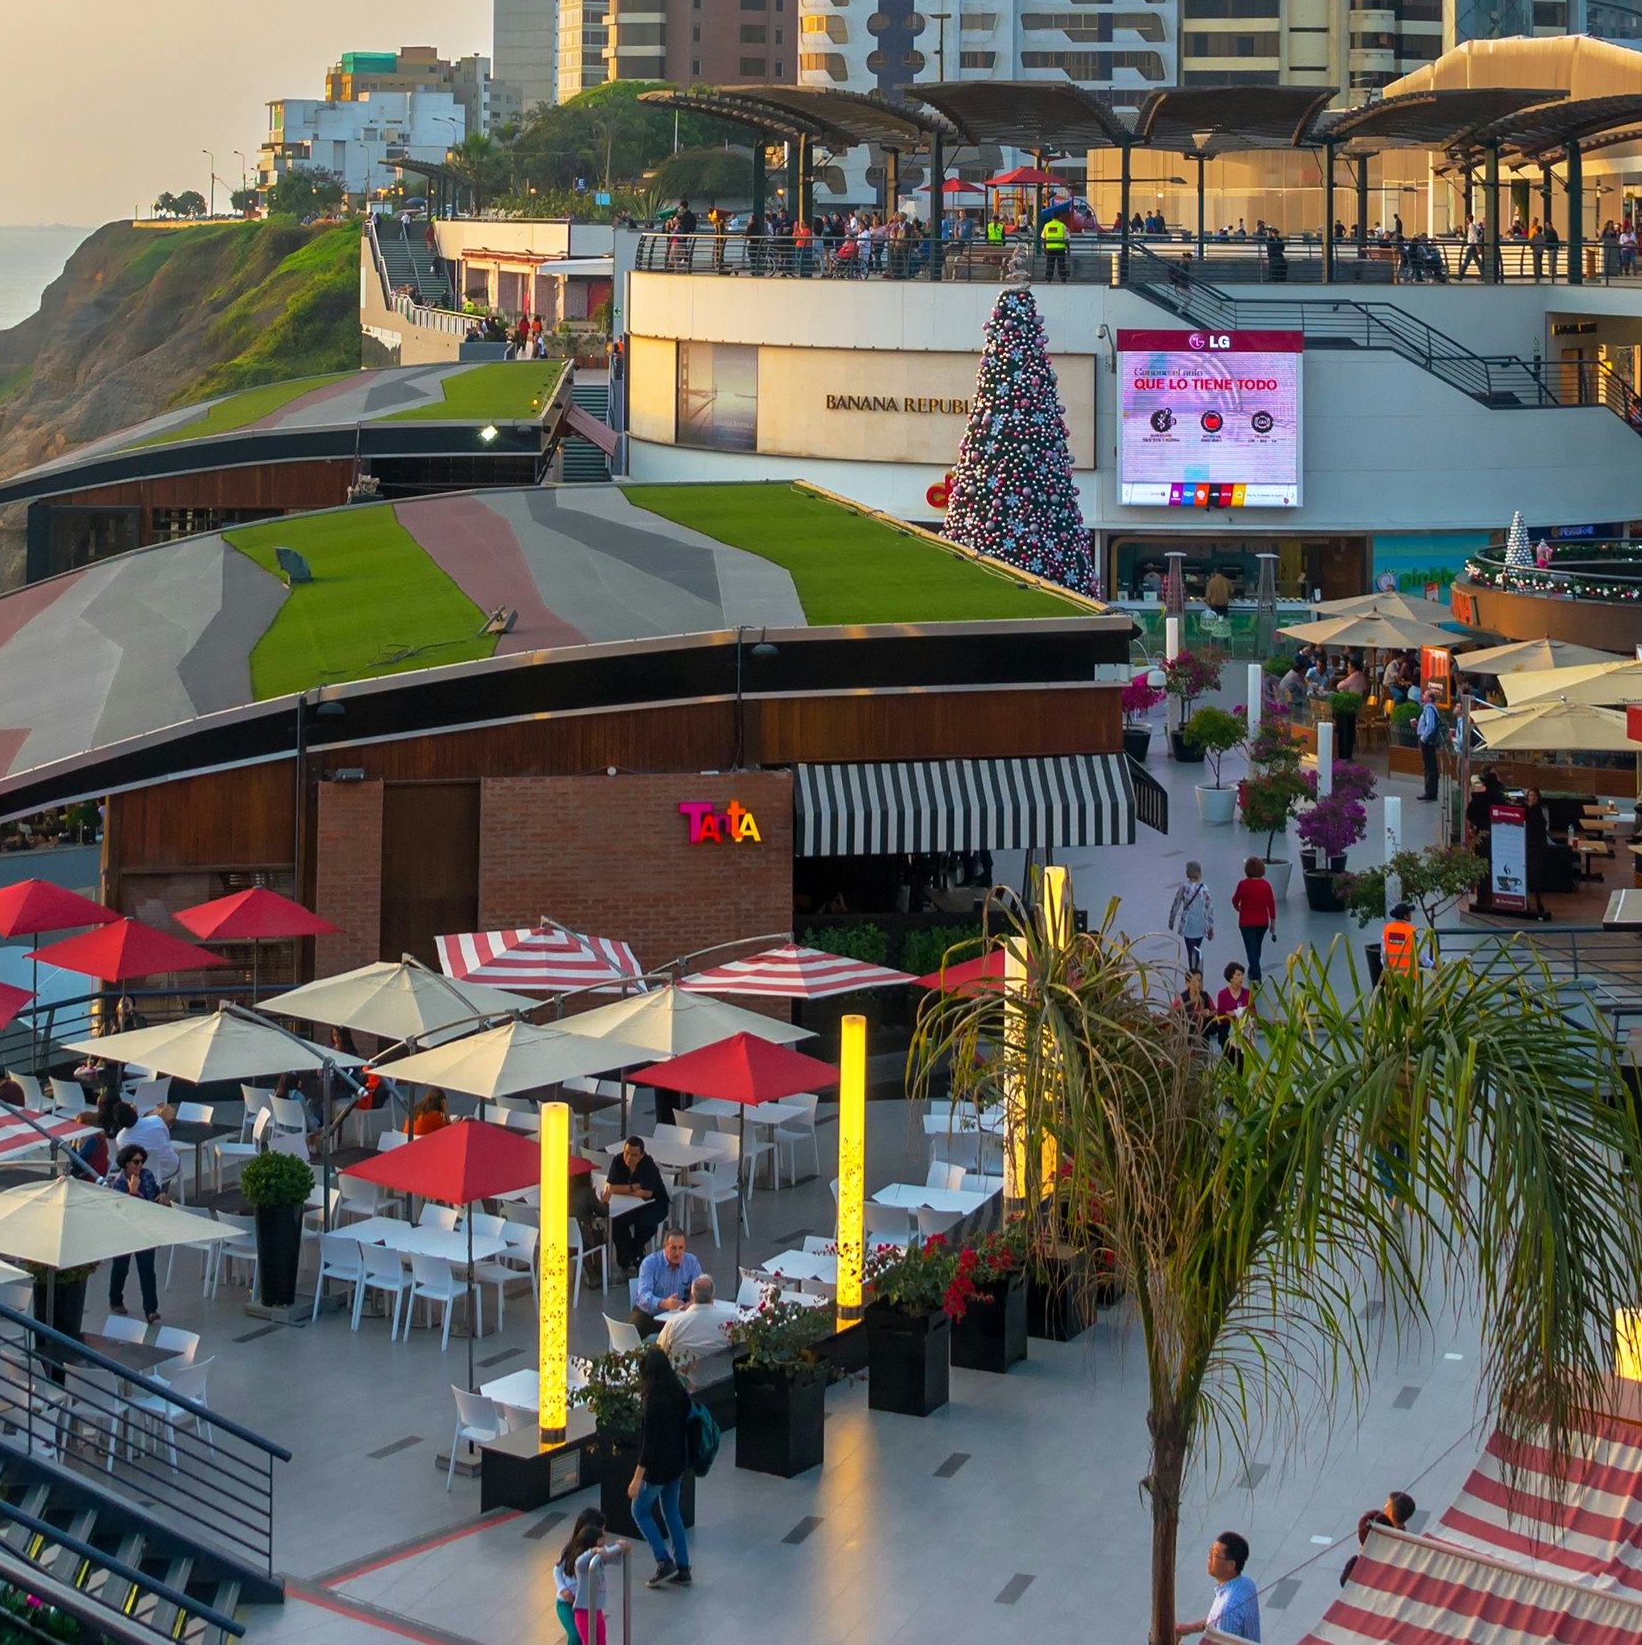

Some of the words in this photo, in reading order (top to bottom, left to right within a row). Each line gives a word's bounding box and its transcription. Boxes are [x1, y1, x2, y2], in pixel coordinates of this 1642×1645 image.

[1209, 335, 1230, 348] LG
[1134, 378, 1165, 391] QUE
[1169, 378, 1188, 390] LO
[1192, 379, 1233, 390] TIENE
[1238, 379, 1277, 391] TODO
[826, 394, 898, 412] BANANA
[904, 397, 971, 414] REPUBL
